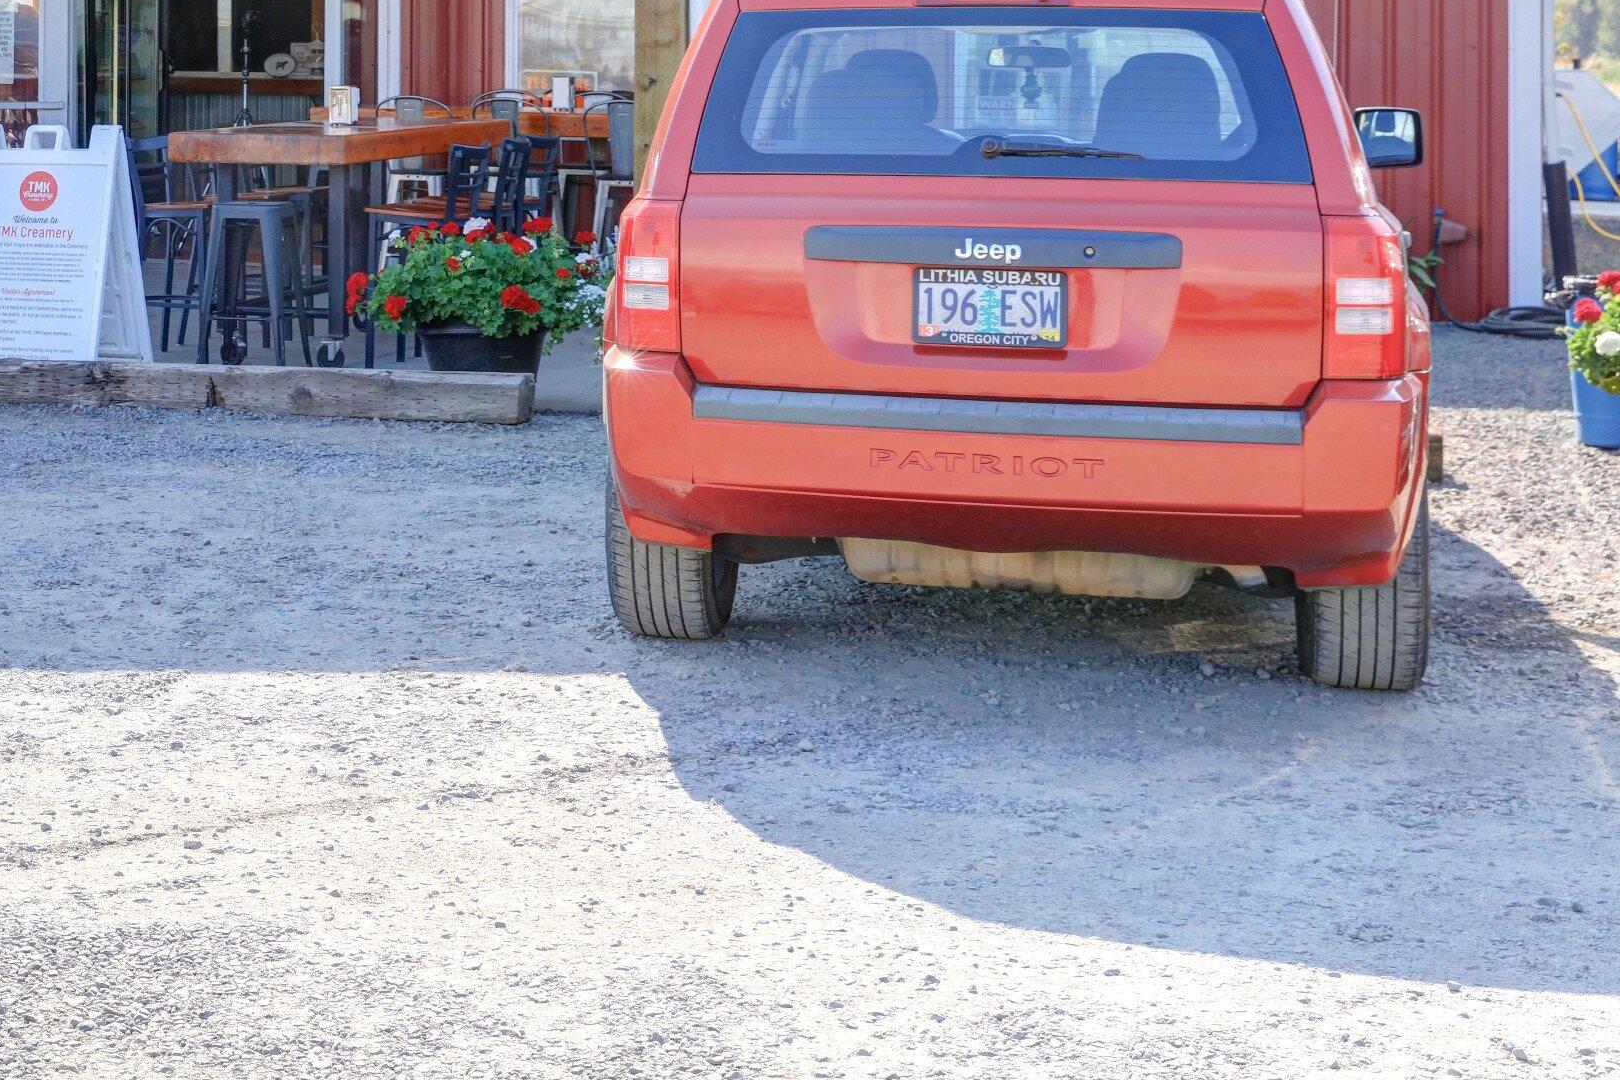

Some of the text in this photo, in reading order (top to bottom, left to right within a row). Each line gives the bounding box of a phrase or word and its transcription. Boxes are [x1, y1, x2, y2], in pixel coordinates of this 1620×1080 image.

[28, 181, 51, 193] TMK
[12, 214, 58, 224] Welcome to
[20, 226, 74, 241] Creamery
[954, 238, 1022, 264] Jeep
[919, 269, 1061, 286] LITHIA SUBARU
[924, 286, 1059, 328] 196 ESW
[950, 333, 1029, 345] OREGON CITY
[869, 448, 1105, 479] PATRIOT
